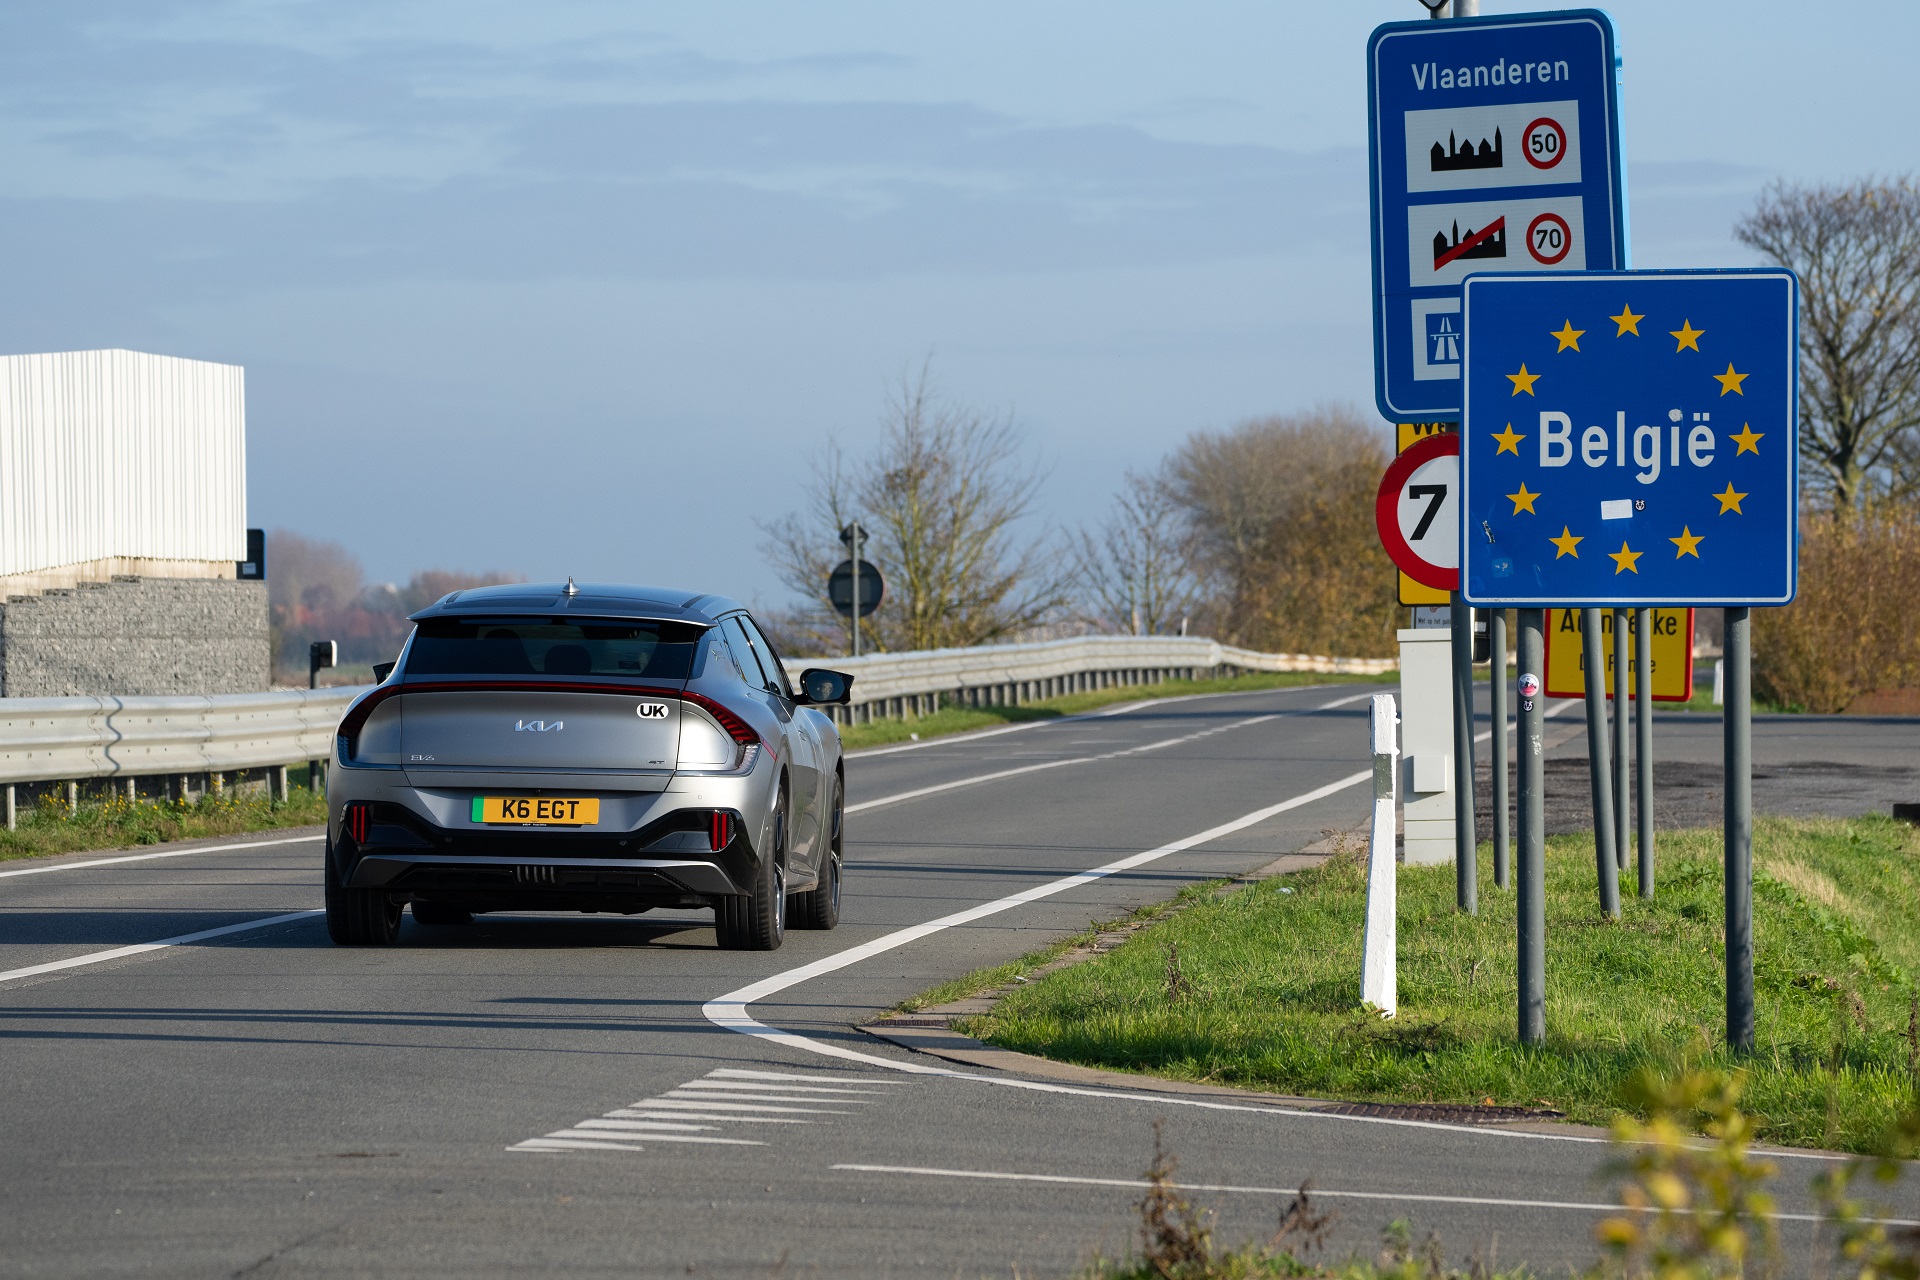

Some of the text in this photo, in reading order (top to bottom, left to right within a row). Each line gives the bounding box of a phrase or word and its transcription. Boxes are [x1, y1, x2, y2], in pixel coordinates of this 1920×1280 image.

[1411, 58, 1569, 90] Vlaanderen
[1531, 133, 1557, 154] 50
[1536, 228, 1562, 249] 70
[1539, 410, 1716, 485] België
[1409, 483, 1448, 541] 7
[639, 705, 665, 718] UK
[502, 799, 580, 820] K6 EGT
